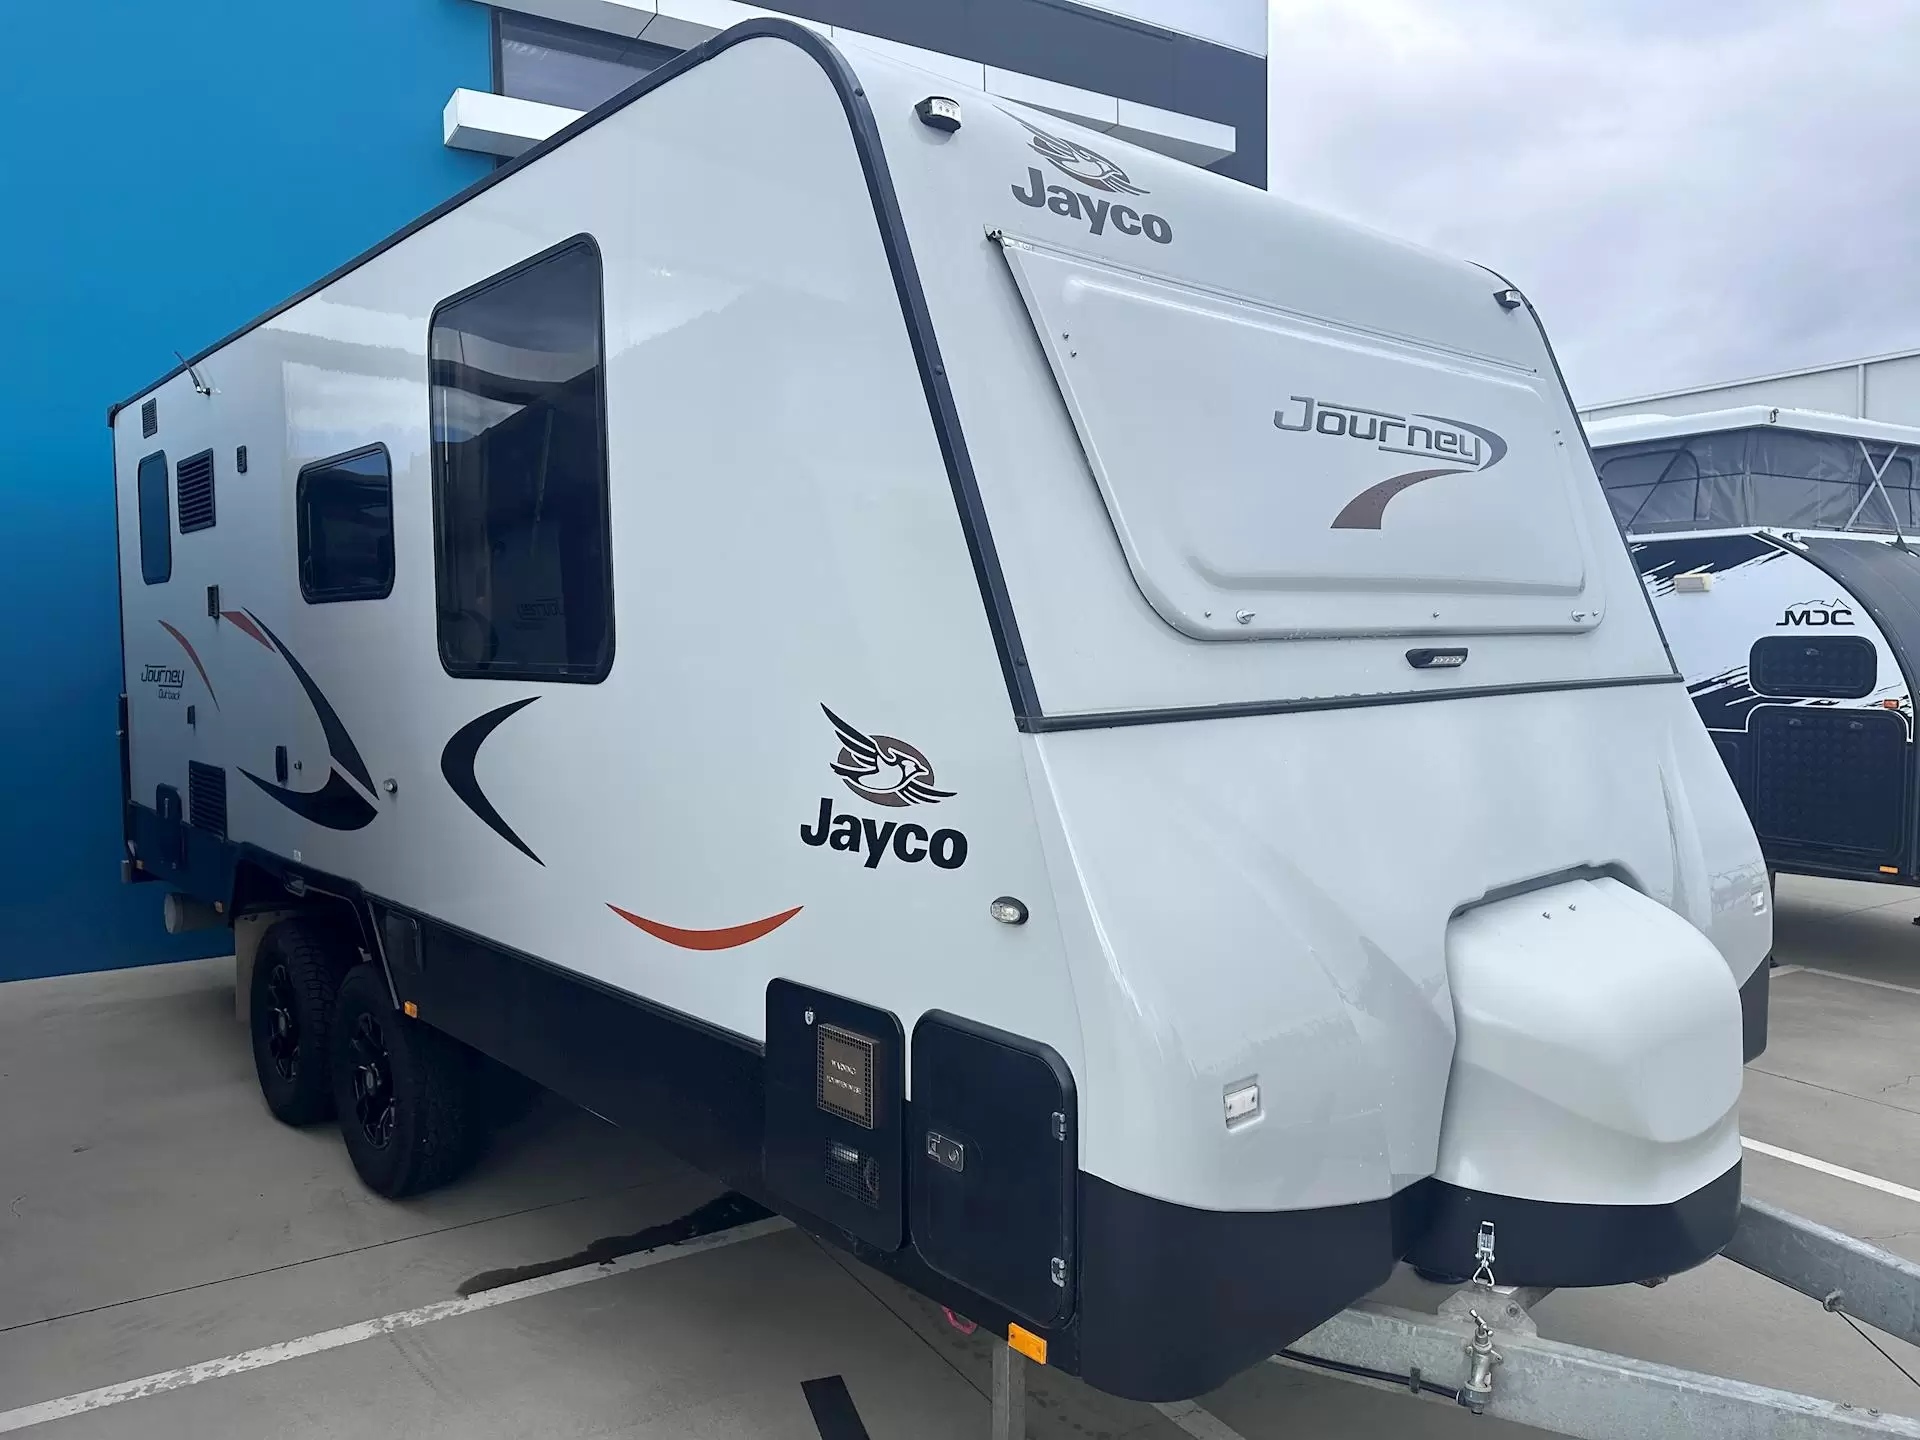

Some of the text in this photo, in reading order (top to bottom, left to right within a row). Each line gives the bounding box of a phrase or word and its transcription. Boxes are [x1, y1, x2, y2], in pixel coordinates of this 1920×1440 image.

[1011, 166, 1173, 244] Jayco
[1273, 395, 1481, 466] Journey
[1775, 609, 1855, 626] MDC
[141, 664, 185, 688] Journey
[800, 797, 968, 870] Jayco
